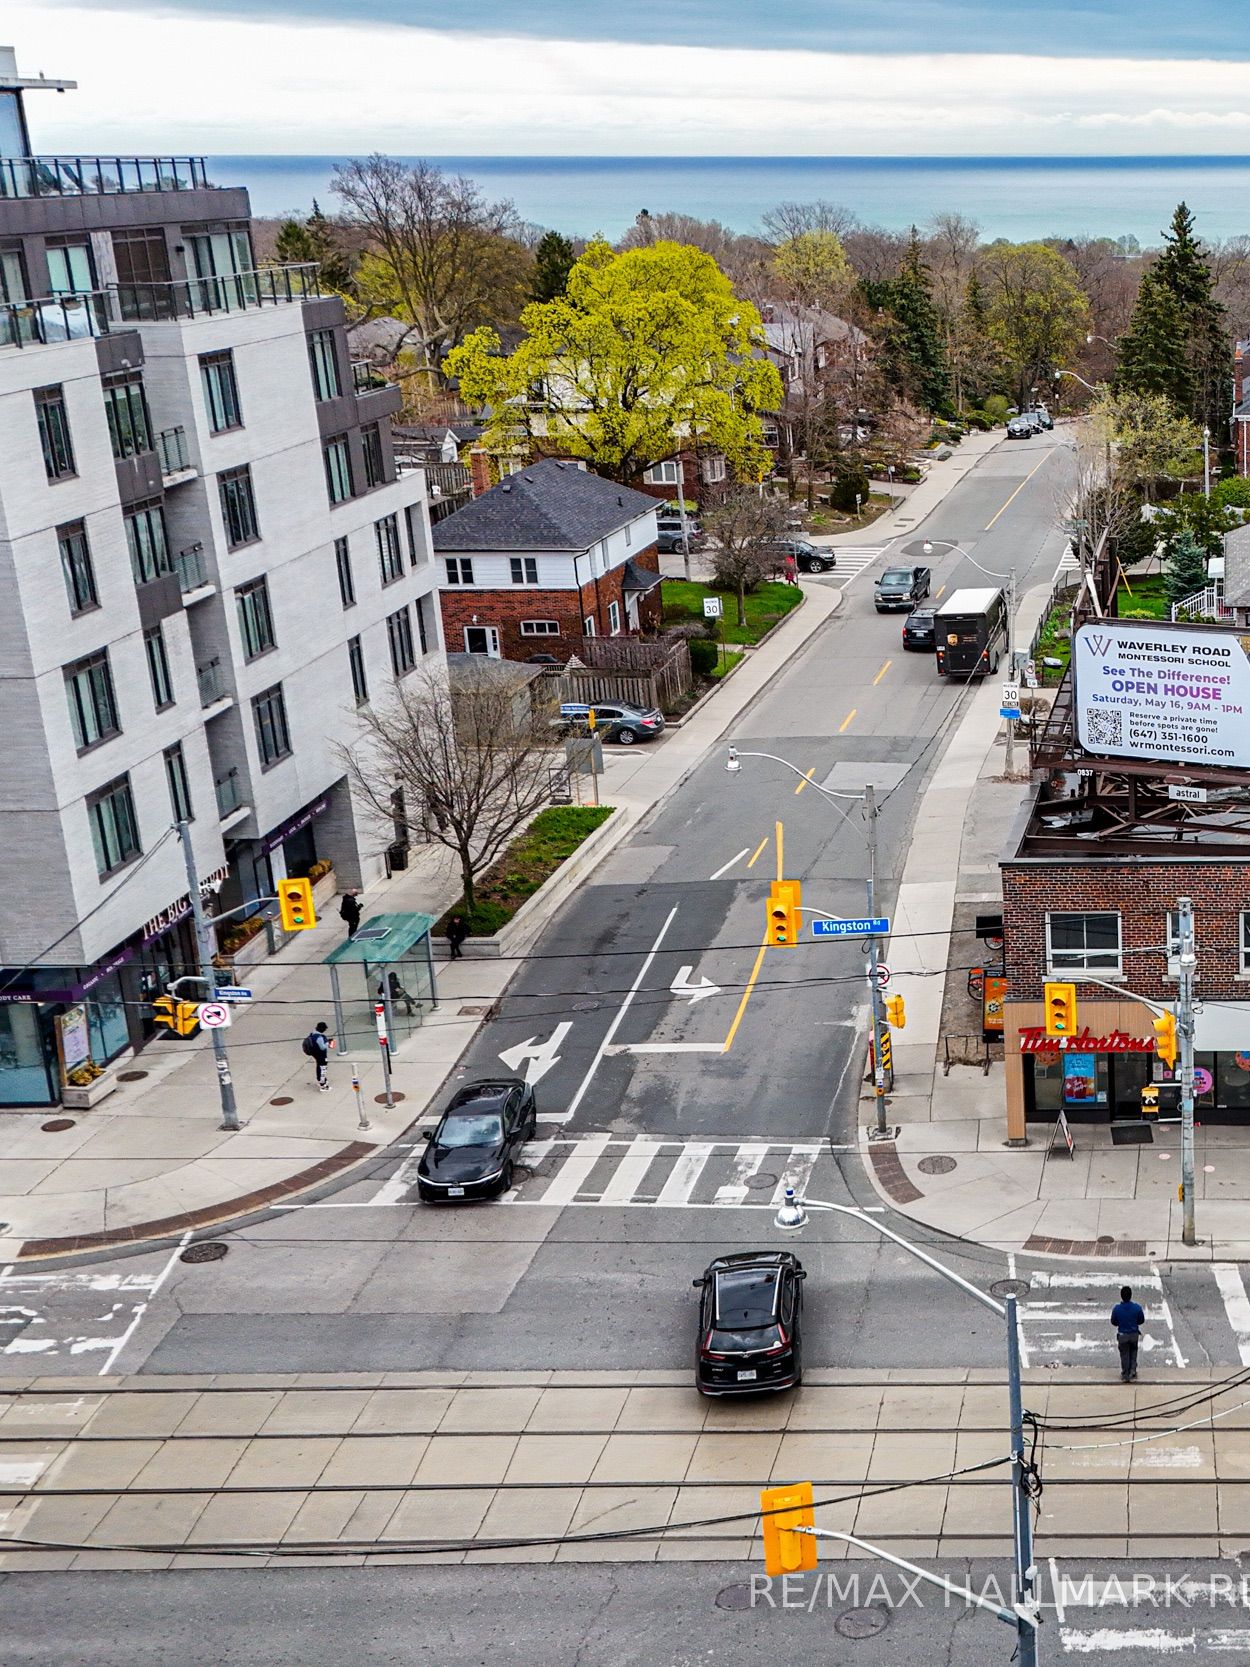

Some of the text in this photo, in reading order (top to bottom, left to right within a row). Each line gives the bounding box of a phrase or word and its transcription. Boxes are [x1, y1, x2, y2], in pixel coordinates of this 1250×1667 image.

[706, 605, 718, 614] 30
[1117, 640, 1231, 657] WAVERLEY ROAD
[1118, 652, 1231, 668] MONTESSORI SCHOOL
[1102, 665, 1231, 685] See The Difference!
[1004, 690, 1017, 700] 30
[1111, 679, 1222, 701] OPEN HOUSE
[1092, 693, 1142, 707] Saturday,
[1145, 698, 1167, 709] May
[1170, 700, 1184, 711] 16,
[1187, 701, 1211, 712] 9AM
[1221, 704, 1243, 714] 1PM
[1129, 711, 1160, 720] Reserve
[1170, 715, 1197, 724] private
[1199, 717, 1218, 726] time
[1129, 719, 1155, 728] before
[1157, 722, 1179, 730] spots
[1195, 726, 1218, 734] gone!
[1129, 728, 1208, 744] (647) 351-1600
[1129, 740, 1235, 757] wrmontessori.com
[1077, 769, 1094, 777] 0837
[1175, 790, 1200, 799] astral
[143, 911, 167, 940] THE
[168, 897, 188, 922] BIG
[822, 920, 871, 934] Kingston
[1065, 1026, 1155, 1052] Hortons
